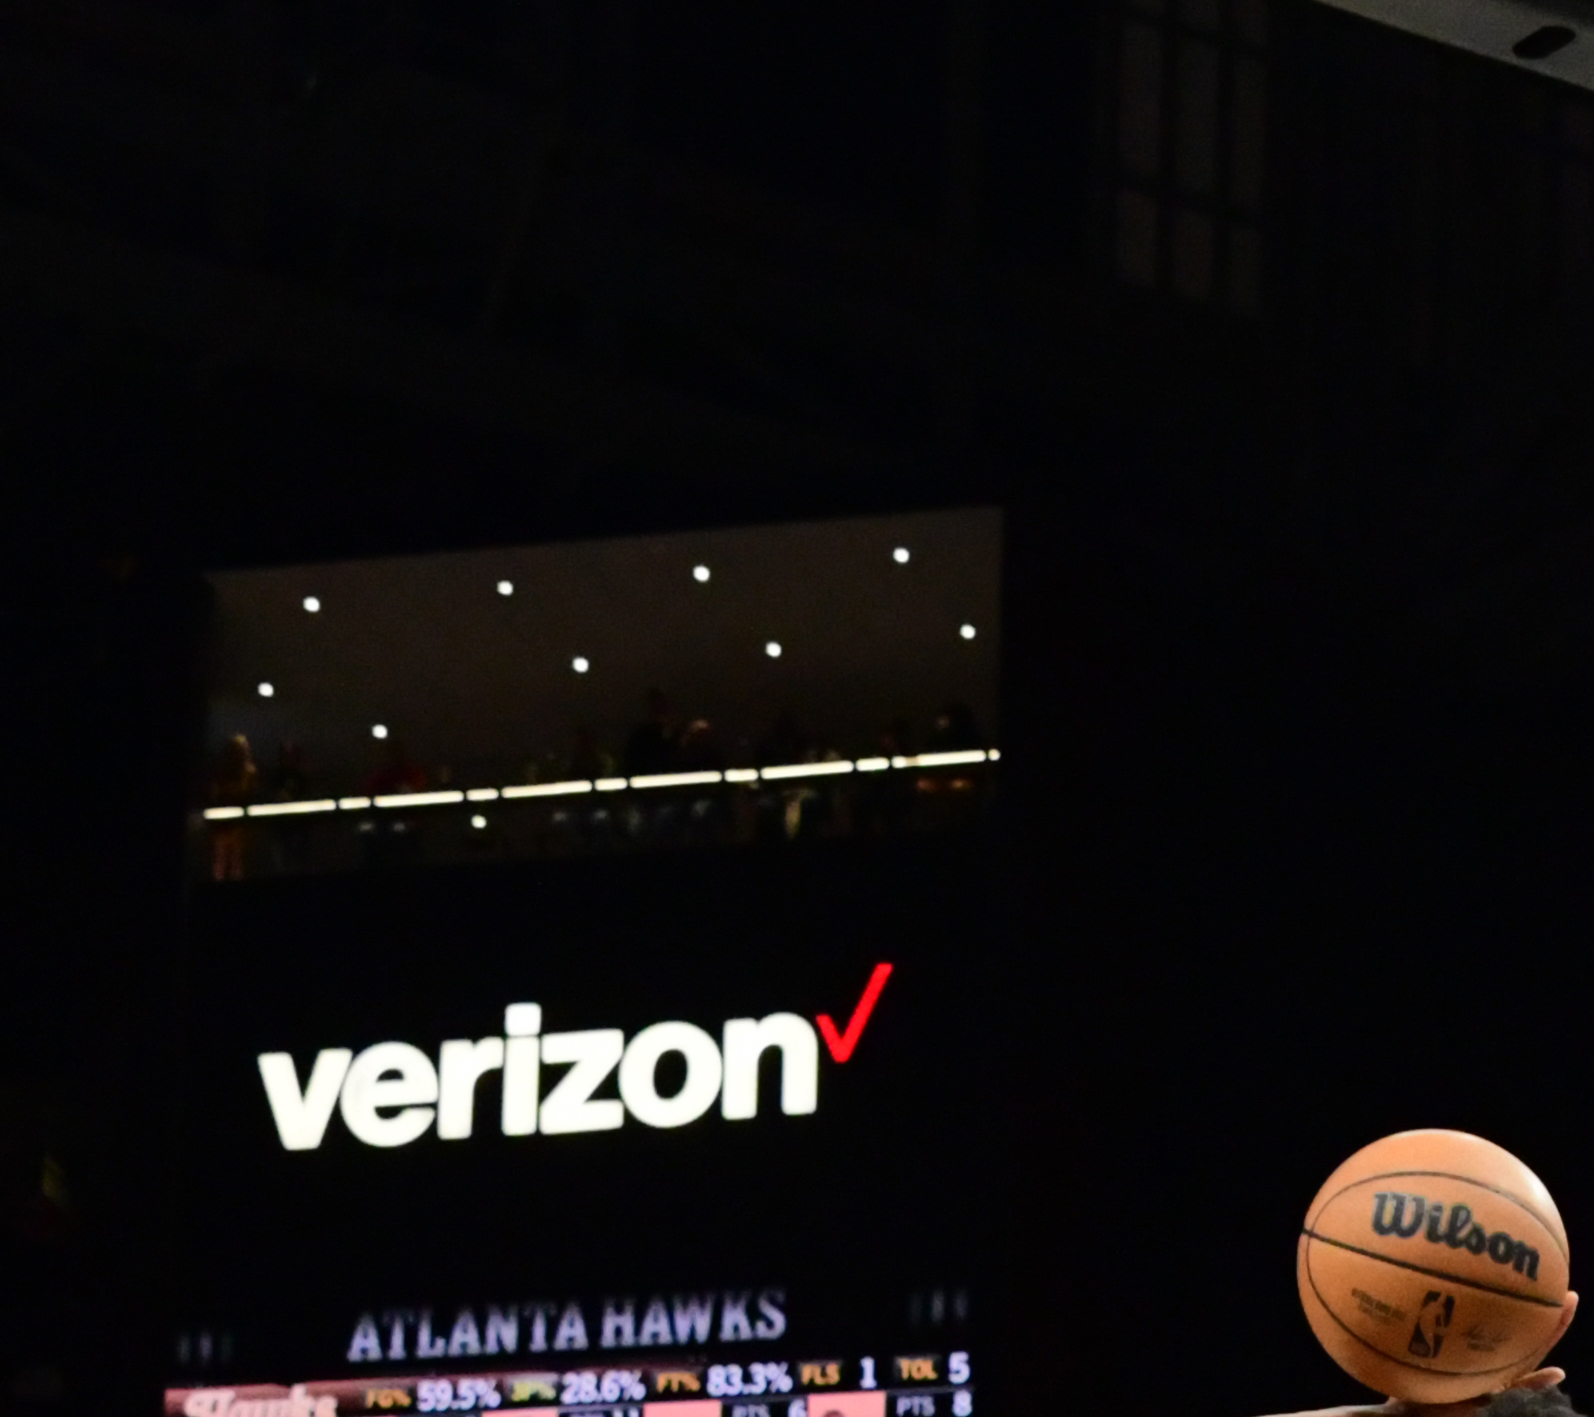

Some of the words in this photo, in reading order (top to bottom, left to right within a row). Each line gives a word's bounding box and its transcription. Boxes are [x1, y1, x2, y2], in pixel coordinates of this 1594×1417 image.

[258, 1002, 819, 1152] verizon
[1372, 1191, 1540, 1282] Wilson
[347, 1303, 588, 1362] ATLANTA
[600, 1289, 788, 1348] HAWKS
[707, 1361, 794, 1397] 83.3%
[860, 1356, 877, 1389] 1
[948, 1351, 971, 1384] 5
[416, 1379, 502, 1412] 59.5%
[561, 1370, 646, 1405] 28.6%
